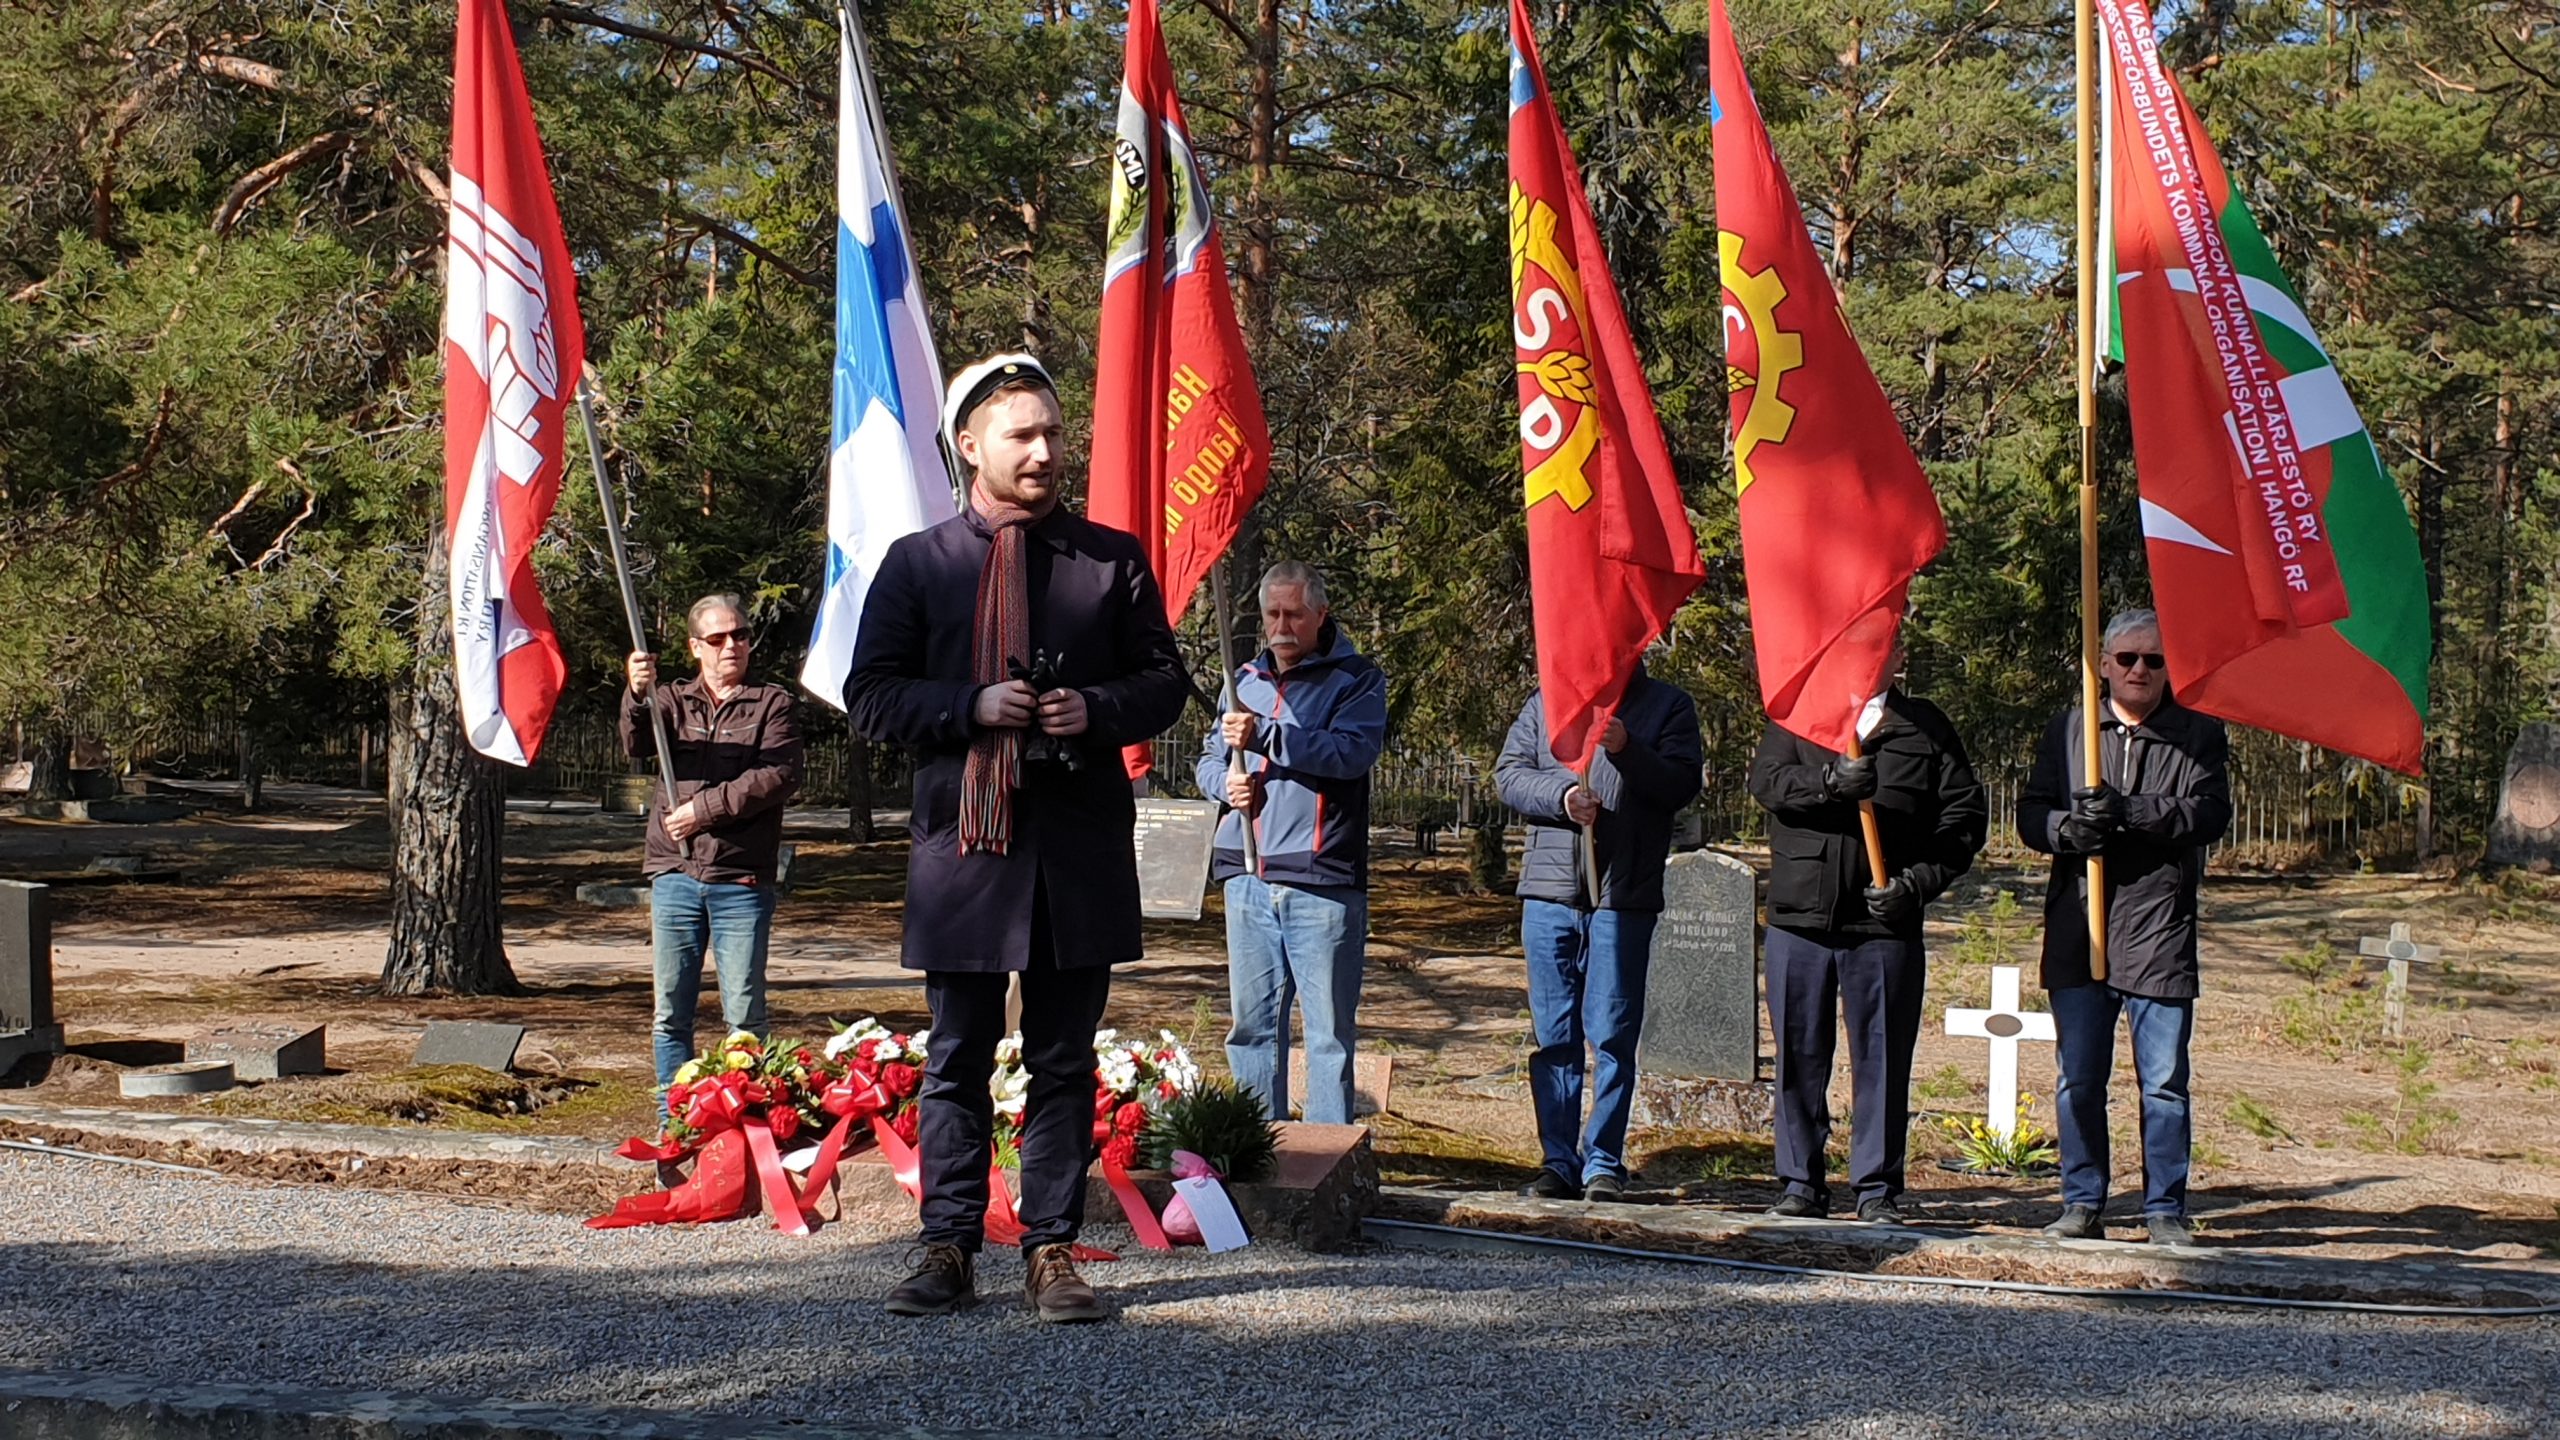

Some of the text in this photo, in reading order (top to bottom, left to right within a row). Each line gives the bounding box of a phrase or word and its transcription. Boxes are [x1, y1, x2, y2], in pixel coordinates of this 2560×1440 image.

[1116, 140, 1145, 186] SML
[2166, 189, 2271, 466] KOMMUNALORGANISATION
[2192, 183, 2231, 278] HANGON
[2222, 281, 2314, 509] KUNNALLISJÄRJESTÖ
[2295, 513, 2322, 543] RY
[2255, 467, 2274, 476] I
[2259, 481, 2302, 560] HANGÖ
[2283, 564, 2309, 593] RF
